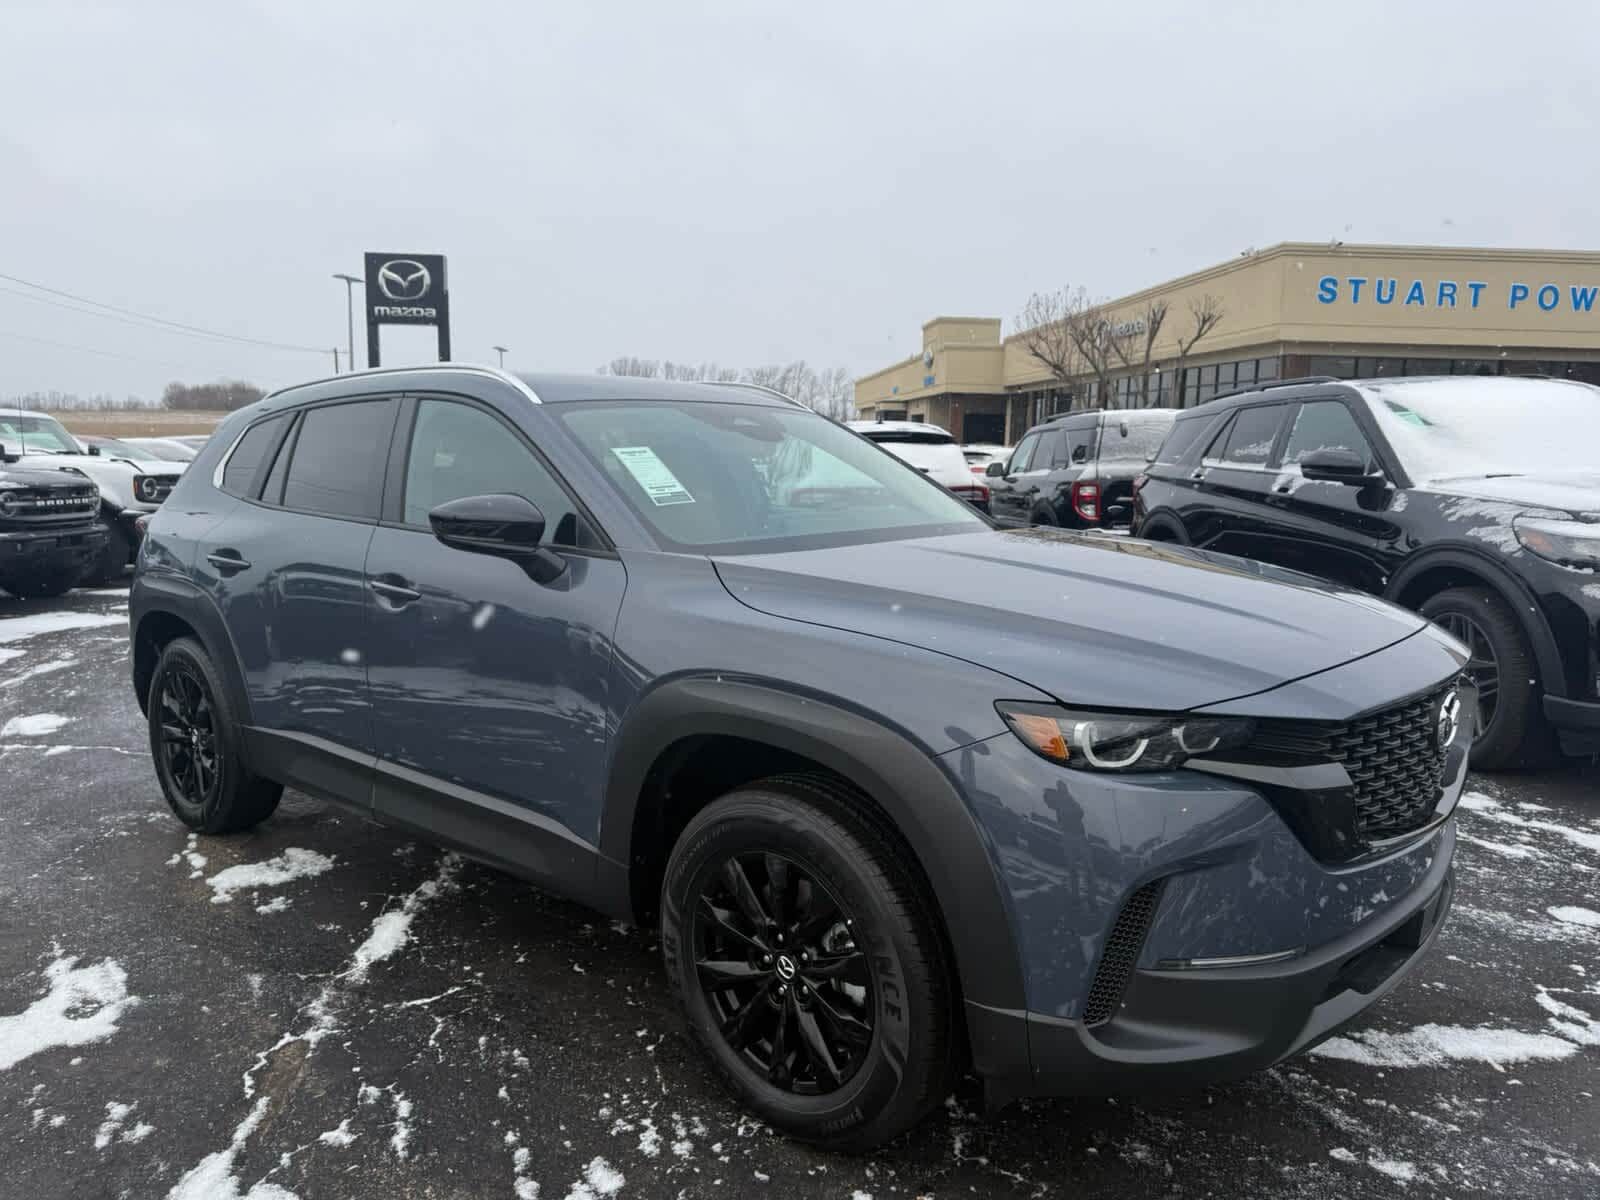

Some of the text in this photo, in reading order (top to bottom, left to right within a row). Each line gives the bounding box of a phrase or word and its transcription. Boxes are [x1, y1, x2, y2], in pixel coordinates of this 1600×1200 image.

[1317, 276, 1599, 311] STUART POW
[374, 305, 437, 318] mazda
